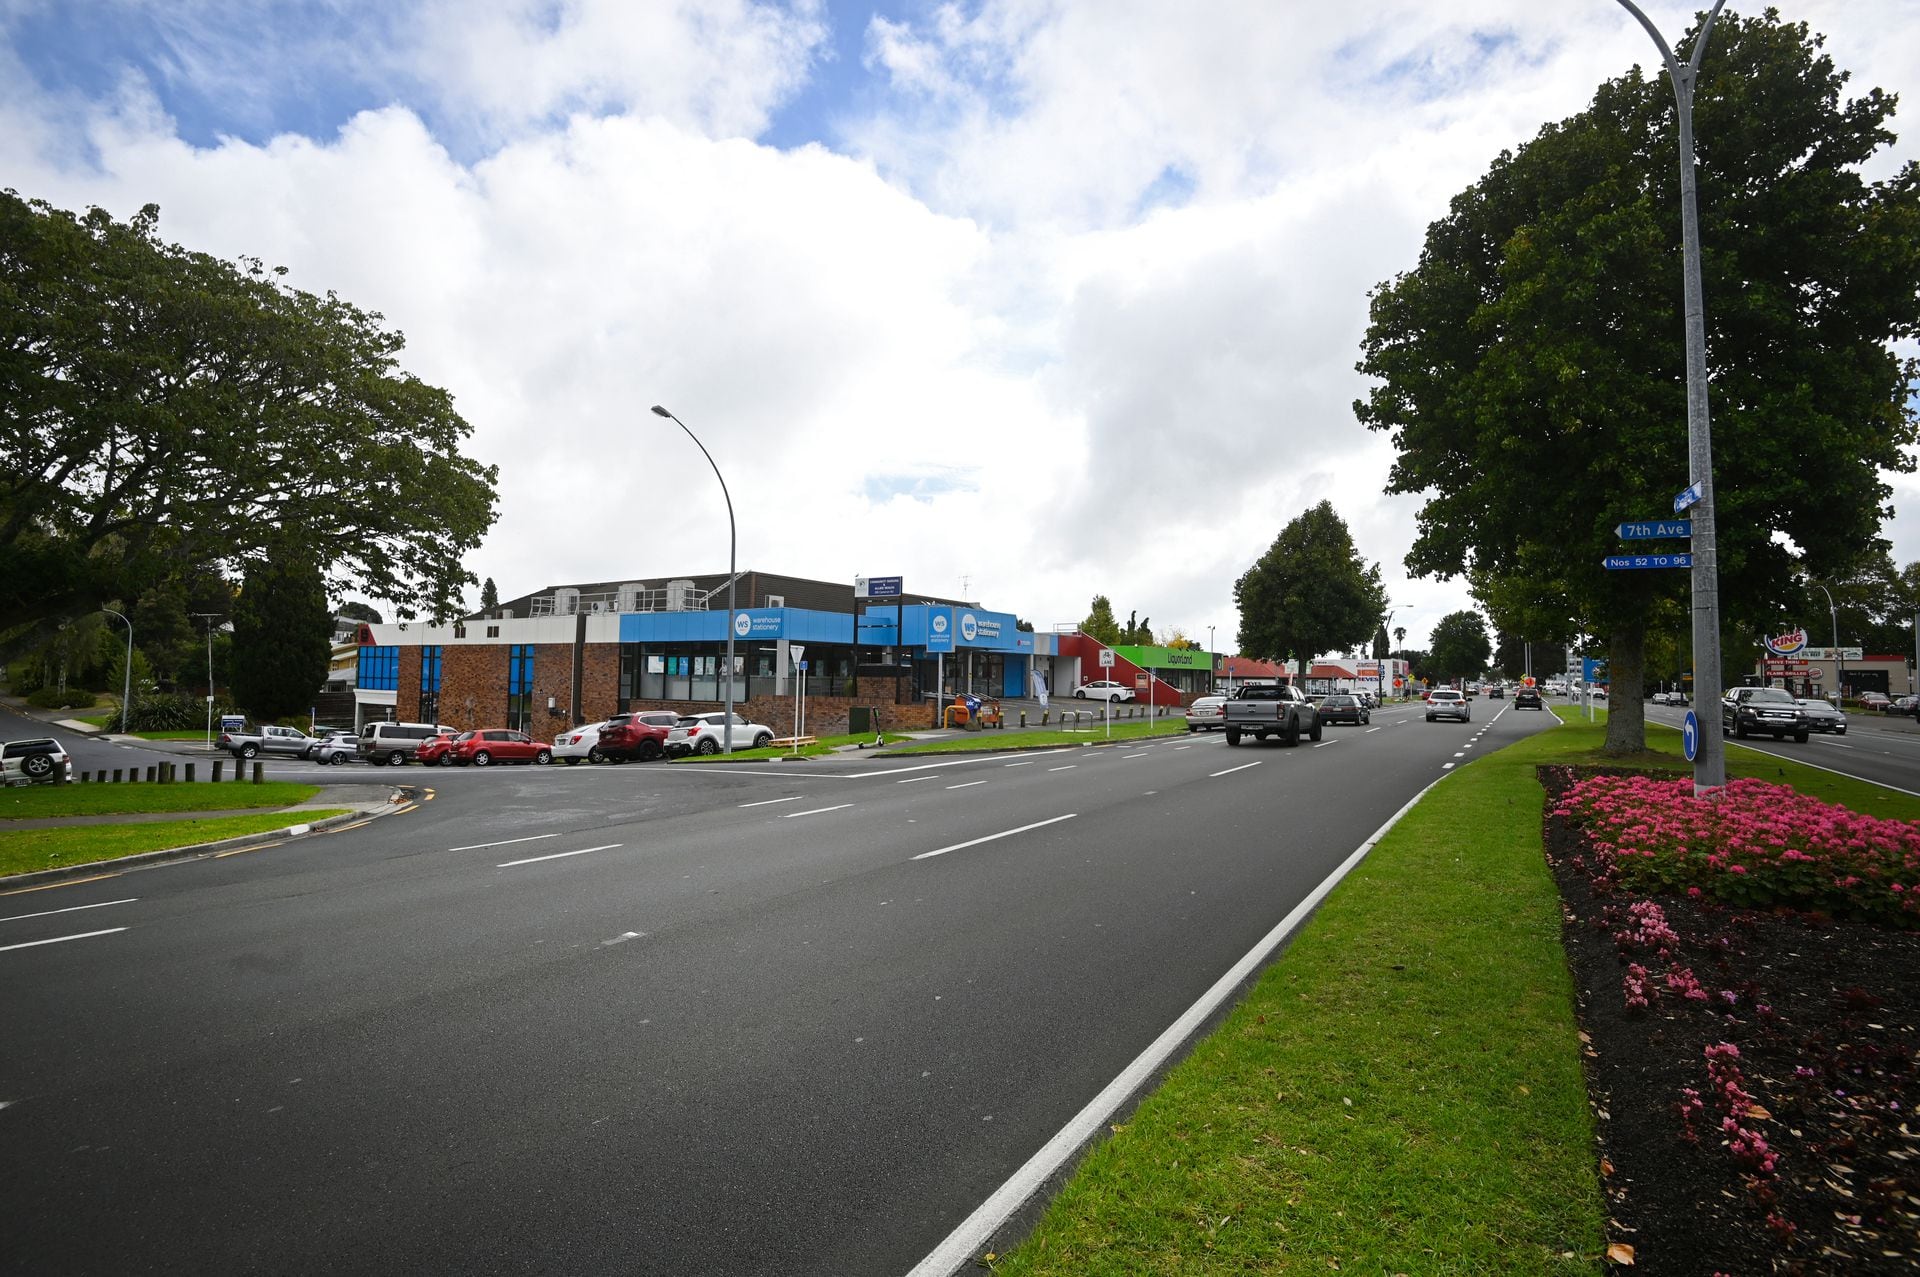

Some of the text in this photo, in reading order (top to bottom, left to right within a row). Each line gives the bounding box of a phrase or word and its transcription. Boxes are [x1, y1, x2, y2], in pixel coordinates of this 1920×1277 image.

[1627, 524, 1684, 536] 7th Ave
[1611, 556, 1687, 567] Nos 52 TO 96
[737, 620, 749, 628] WS
[965, 622, 975, 632] WS
[977, 620, 1000, 629] warehouse
[977, 629, 999, 638] stationery
[1771, 633, 1802, 648] KING
